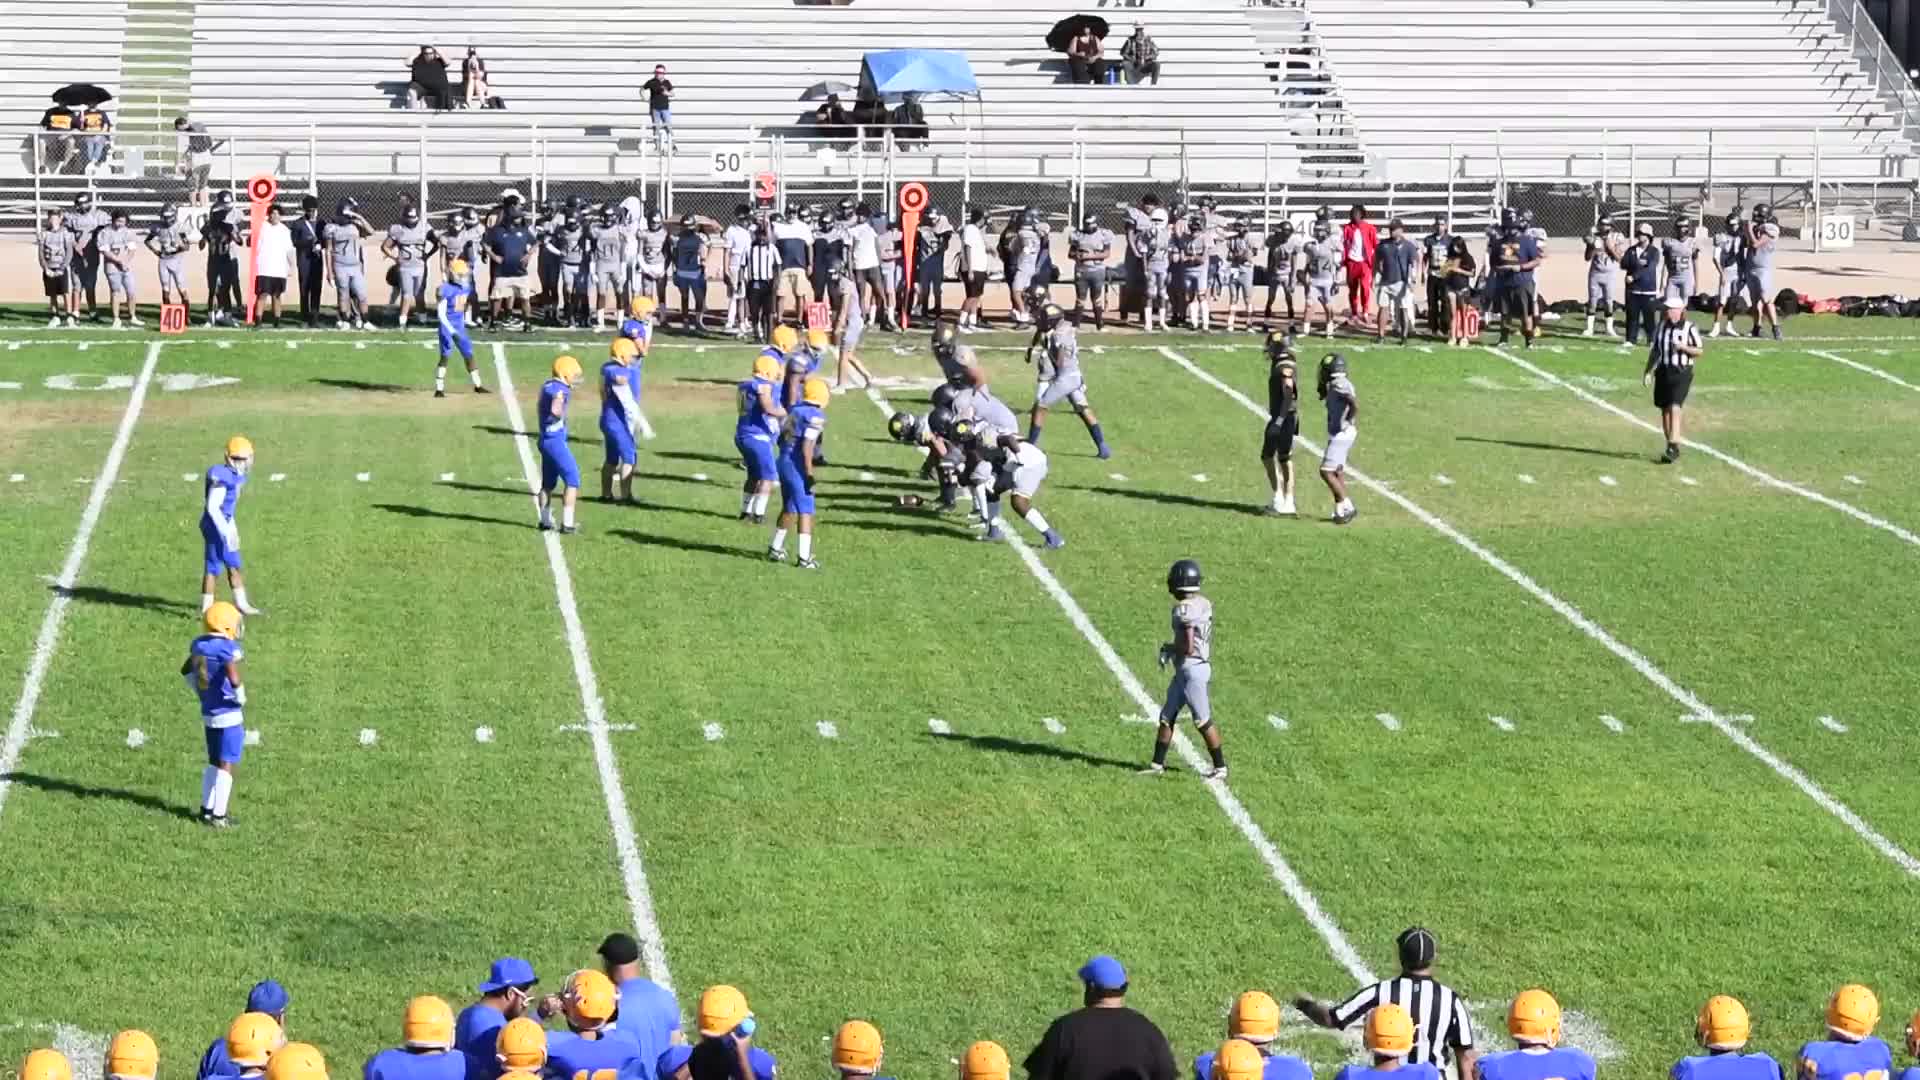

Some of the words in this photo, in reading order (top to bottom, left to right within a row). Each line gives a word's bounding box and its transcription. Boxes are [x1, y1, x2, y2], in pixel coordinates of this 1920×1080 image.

[715, 153, 741, 172] 50
[1824, 222, 1850, 241] 30
[162, 307, 184, 331] 40
